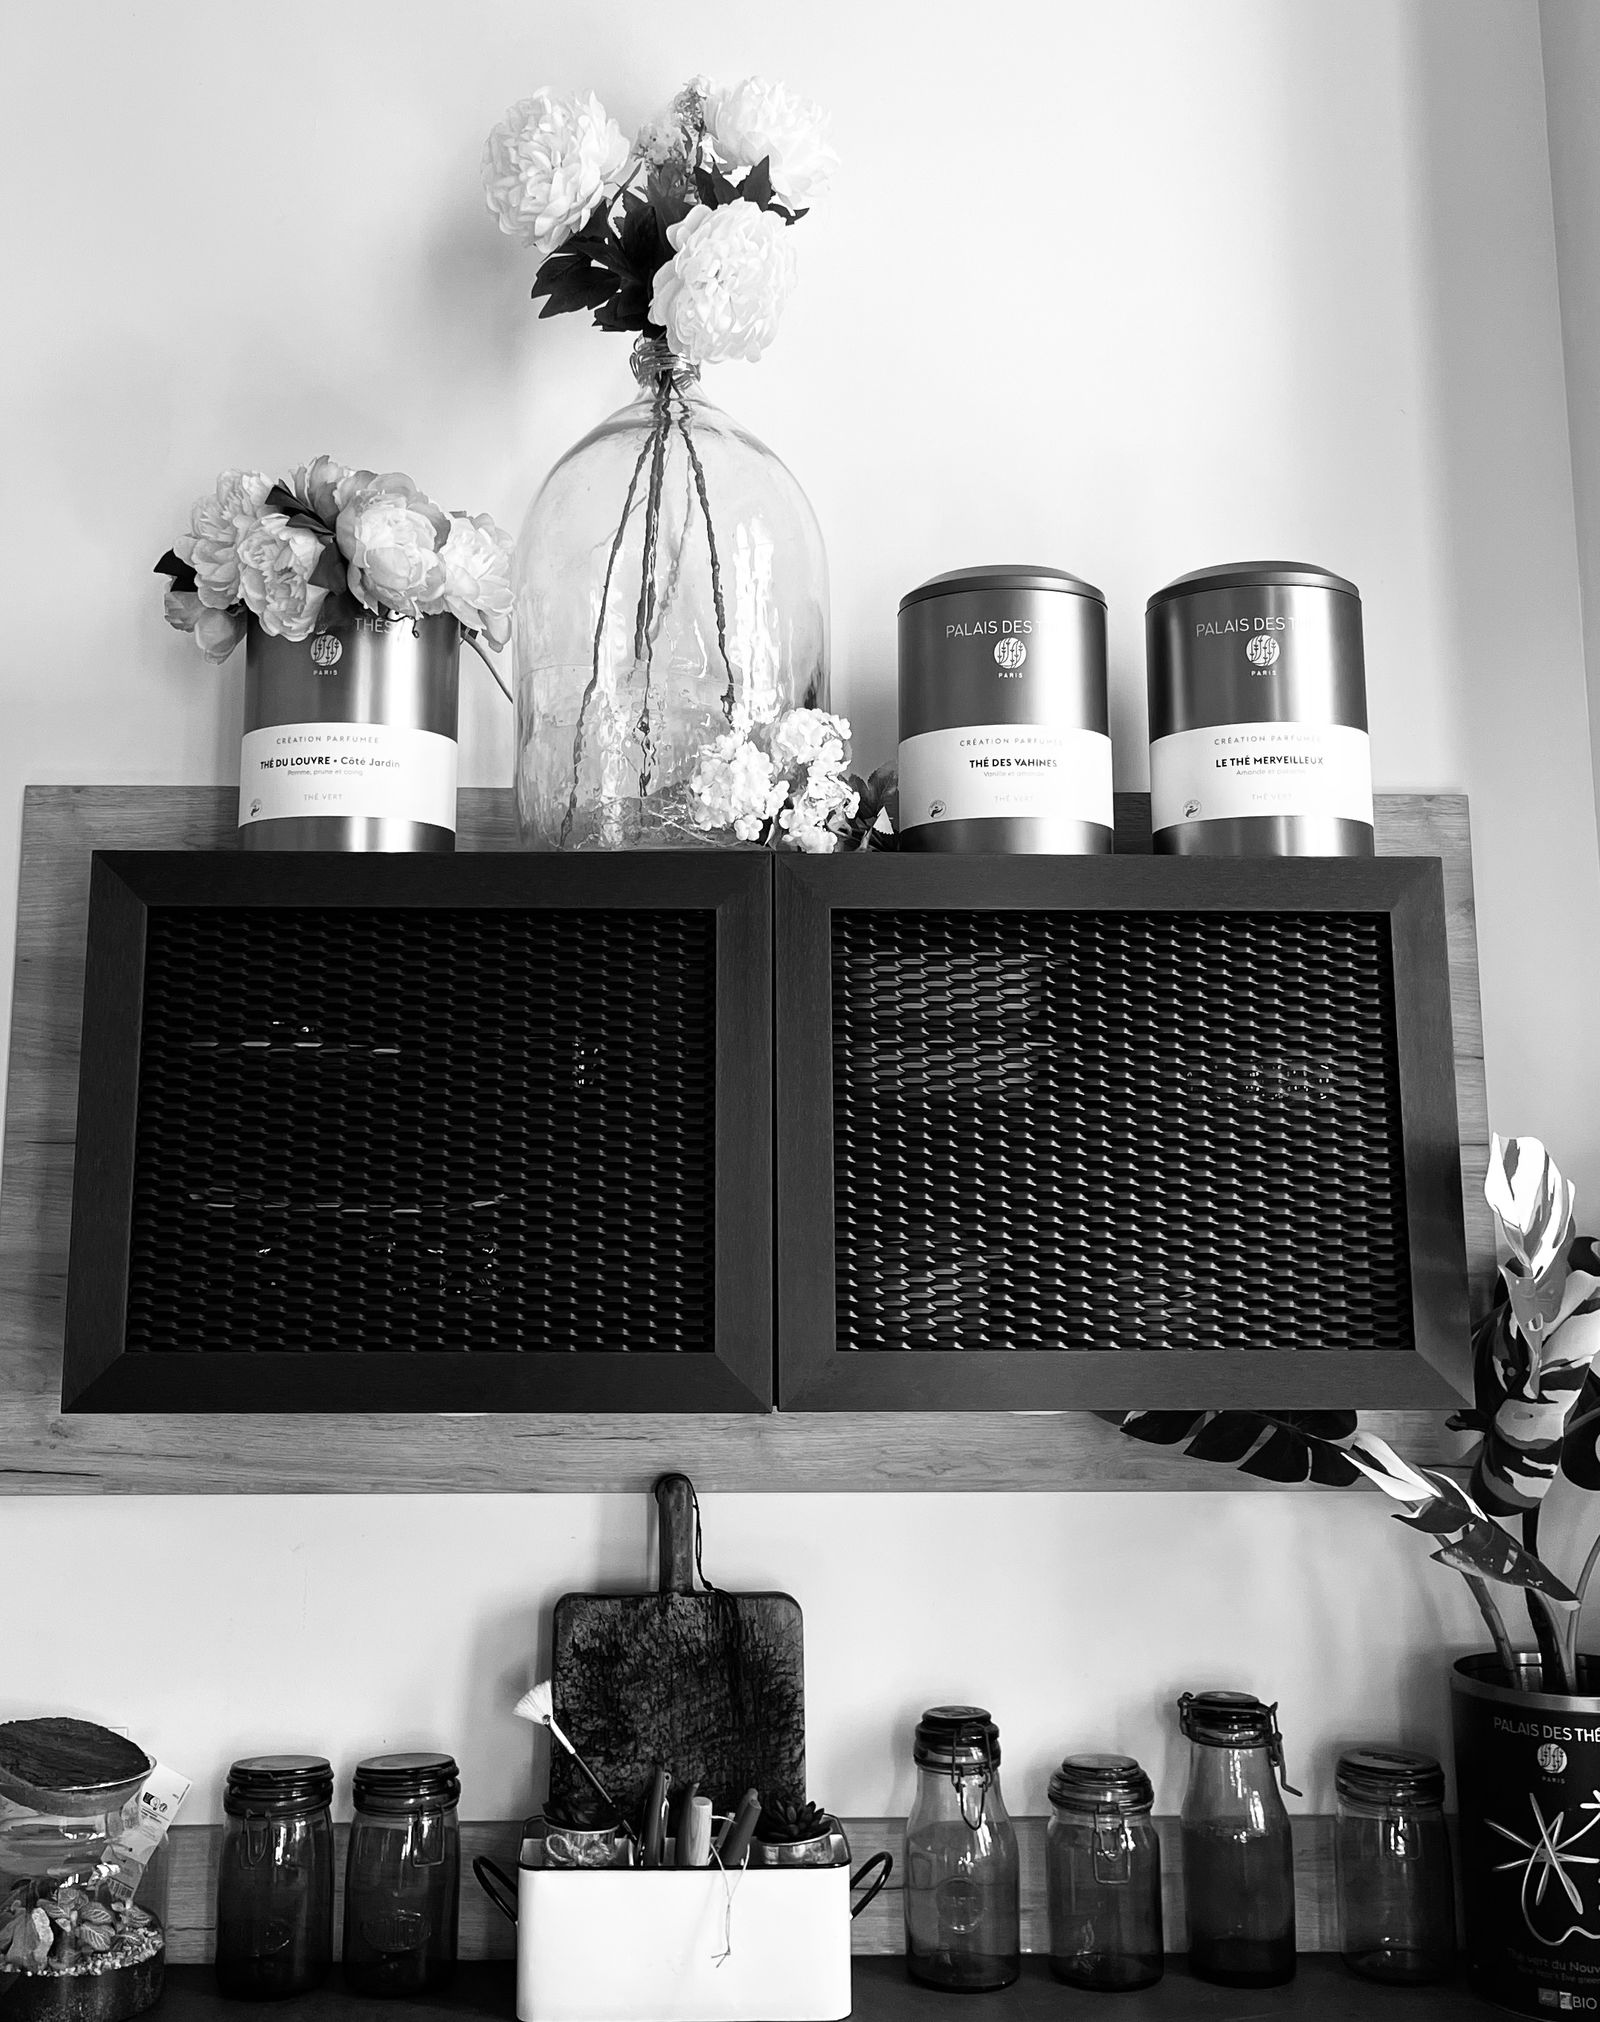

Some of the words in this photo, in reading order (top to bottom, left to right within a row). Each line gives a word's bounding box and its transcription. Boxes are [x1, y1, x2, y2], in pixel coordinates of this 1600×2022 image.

[946, 620, 998, 639] PALAIS
[1002, 619, 1033, 634] DES
[1196, 618, 1249, 637] PALAIS
[1253, 617, 1286, 632] DES
[276, 735, 322, 745] CRÉATION
[959, 737, 1010, 748] CRÉATION
[1214, 735, 1266, 746] CRÉATION
[260, 756, 274, 769] THÉ
[275, 758, 289, 768] DU
[290, 756, 331, 767] LOUVRE
[340, 756, 366, 767] Côté
[369, 757, 400, 769] Jardin
[969, 756, 989, 769] THÉ
[992, 758, 1012, 768] DES
[1215, 758, 1228, 768] LE
[1229, 755, 1251, 767] THÉ
[1253, 756, 1324, 766] MERVEILLEUX
[321, 793, 343, 801] VERT
[1493, 1716, 1540, 1737] PALAIS
[1542, 1724, 1573, 1741] DES
[1541, 1775, 1566, 1785] PARIS
[1551, 1959, 1566, 1971] du
[1572, 1995, 1598, 2011] BIO
